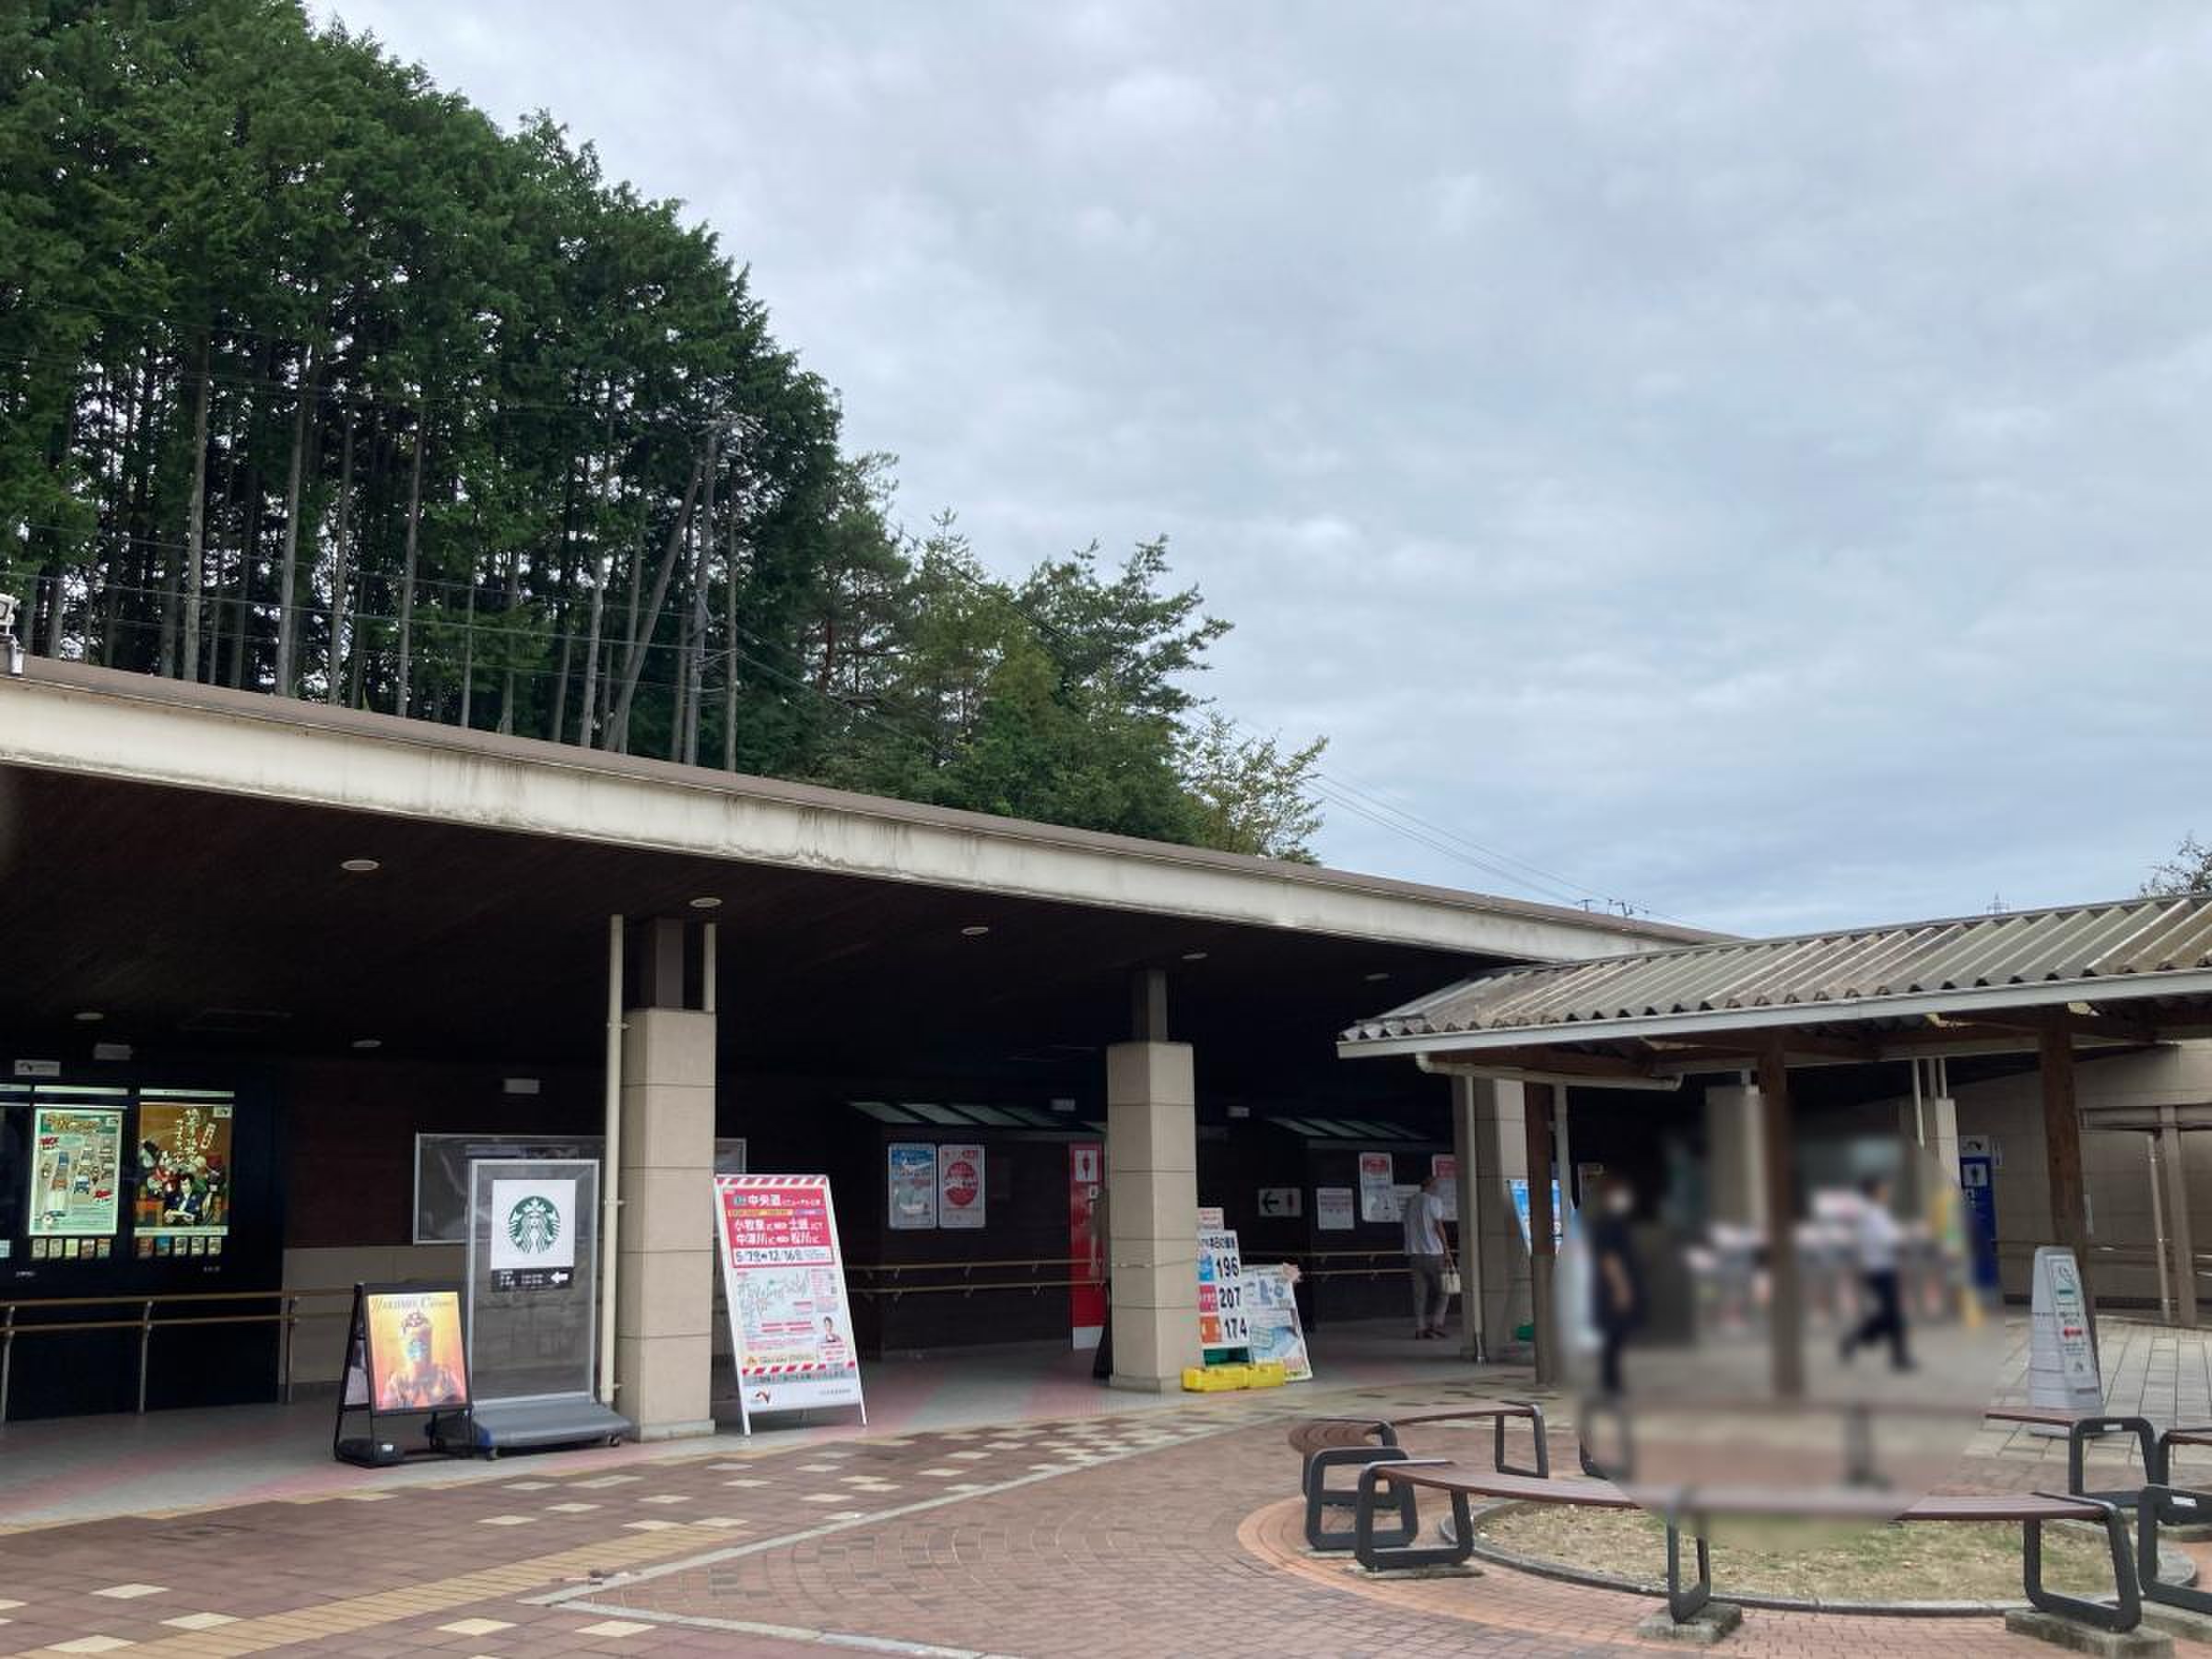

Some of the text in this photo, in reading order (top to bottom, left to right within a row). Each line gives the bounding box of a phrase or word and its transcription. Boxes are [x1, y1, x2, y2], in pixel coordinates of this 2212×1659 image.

[1217, 1256, 1240, 1278] 196
[1219, 1287, 1241, 1308] 207
[1225, 1318, 1247, 1338] 174
